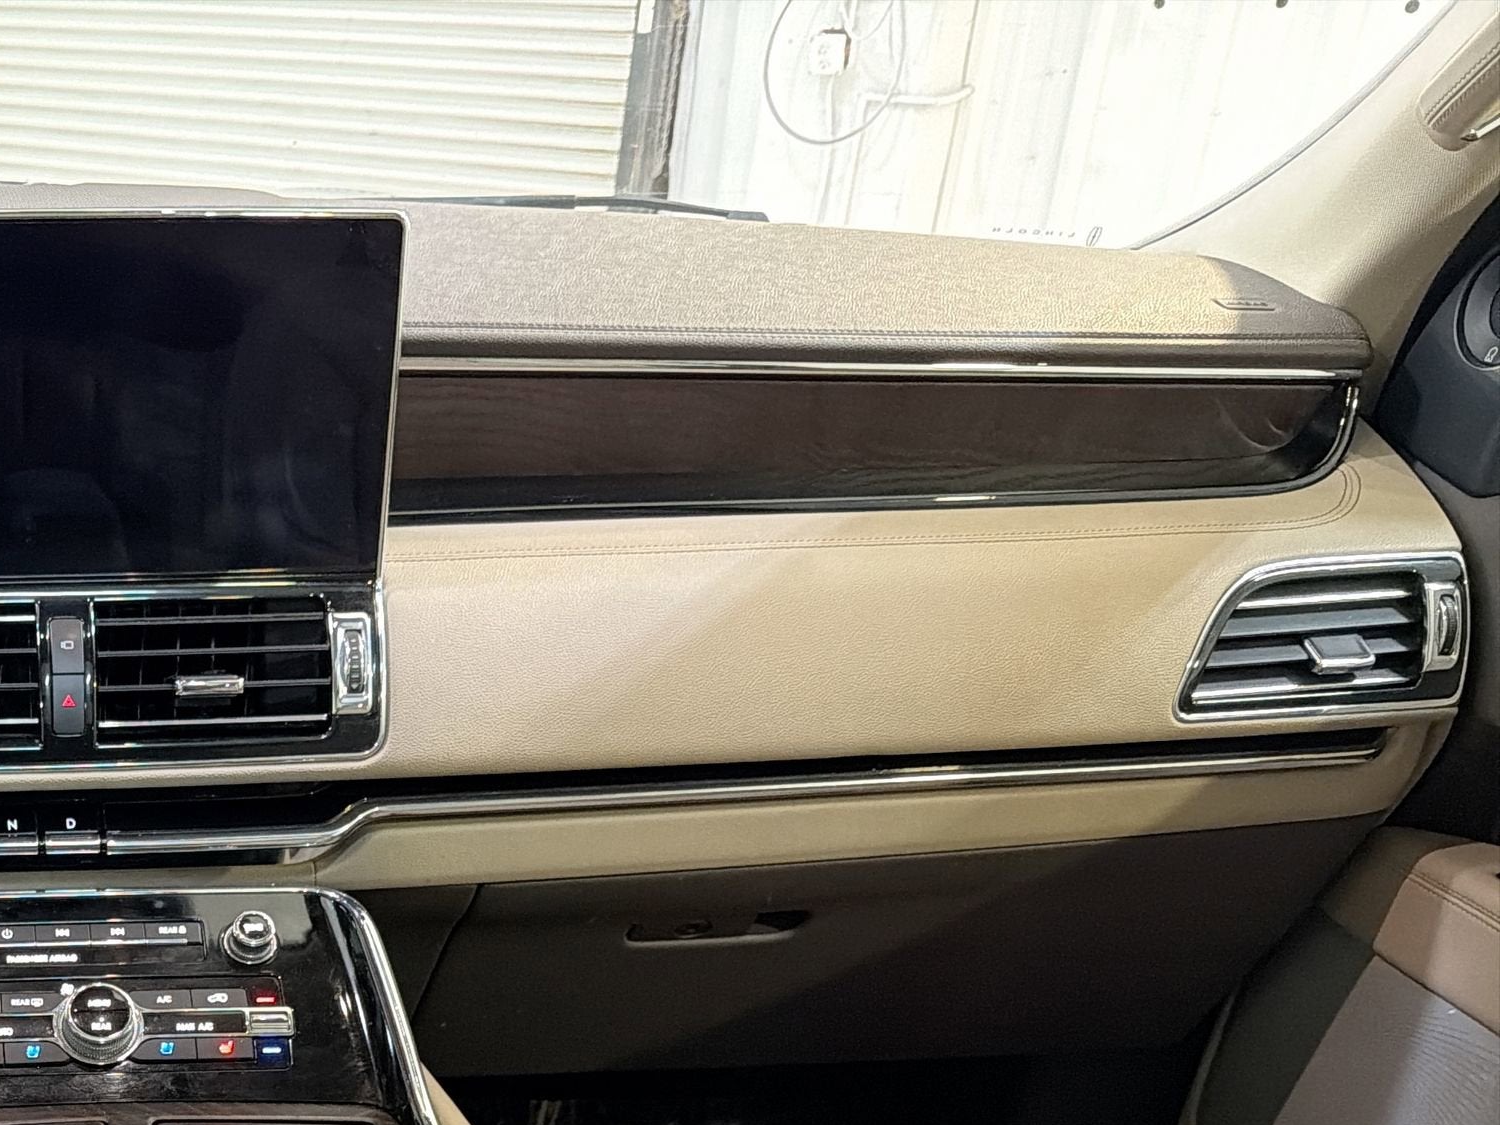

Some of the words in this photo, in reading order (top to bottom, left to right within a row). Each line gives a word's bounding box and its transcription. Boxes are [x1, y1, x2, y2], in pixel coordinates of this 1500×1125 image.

[7, 819, 18, 831] N
[65, 817, 77, 830] D
[10, 998, 30, 1006] REAR
[156, 995, 173, 1004] A/C
[91, 1022, 112, 1031] REAR
[197, 1022, 214, 1031] A/C
